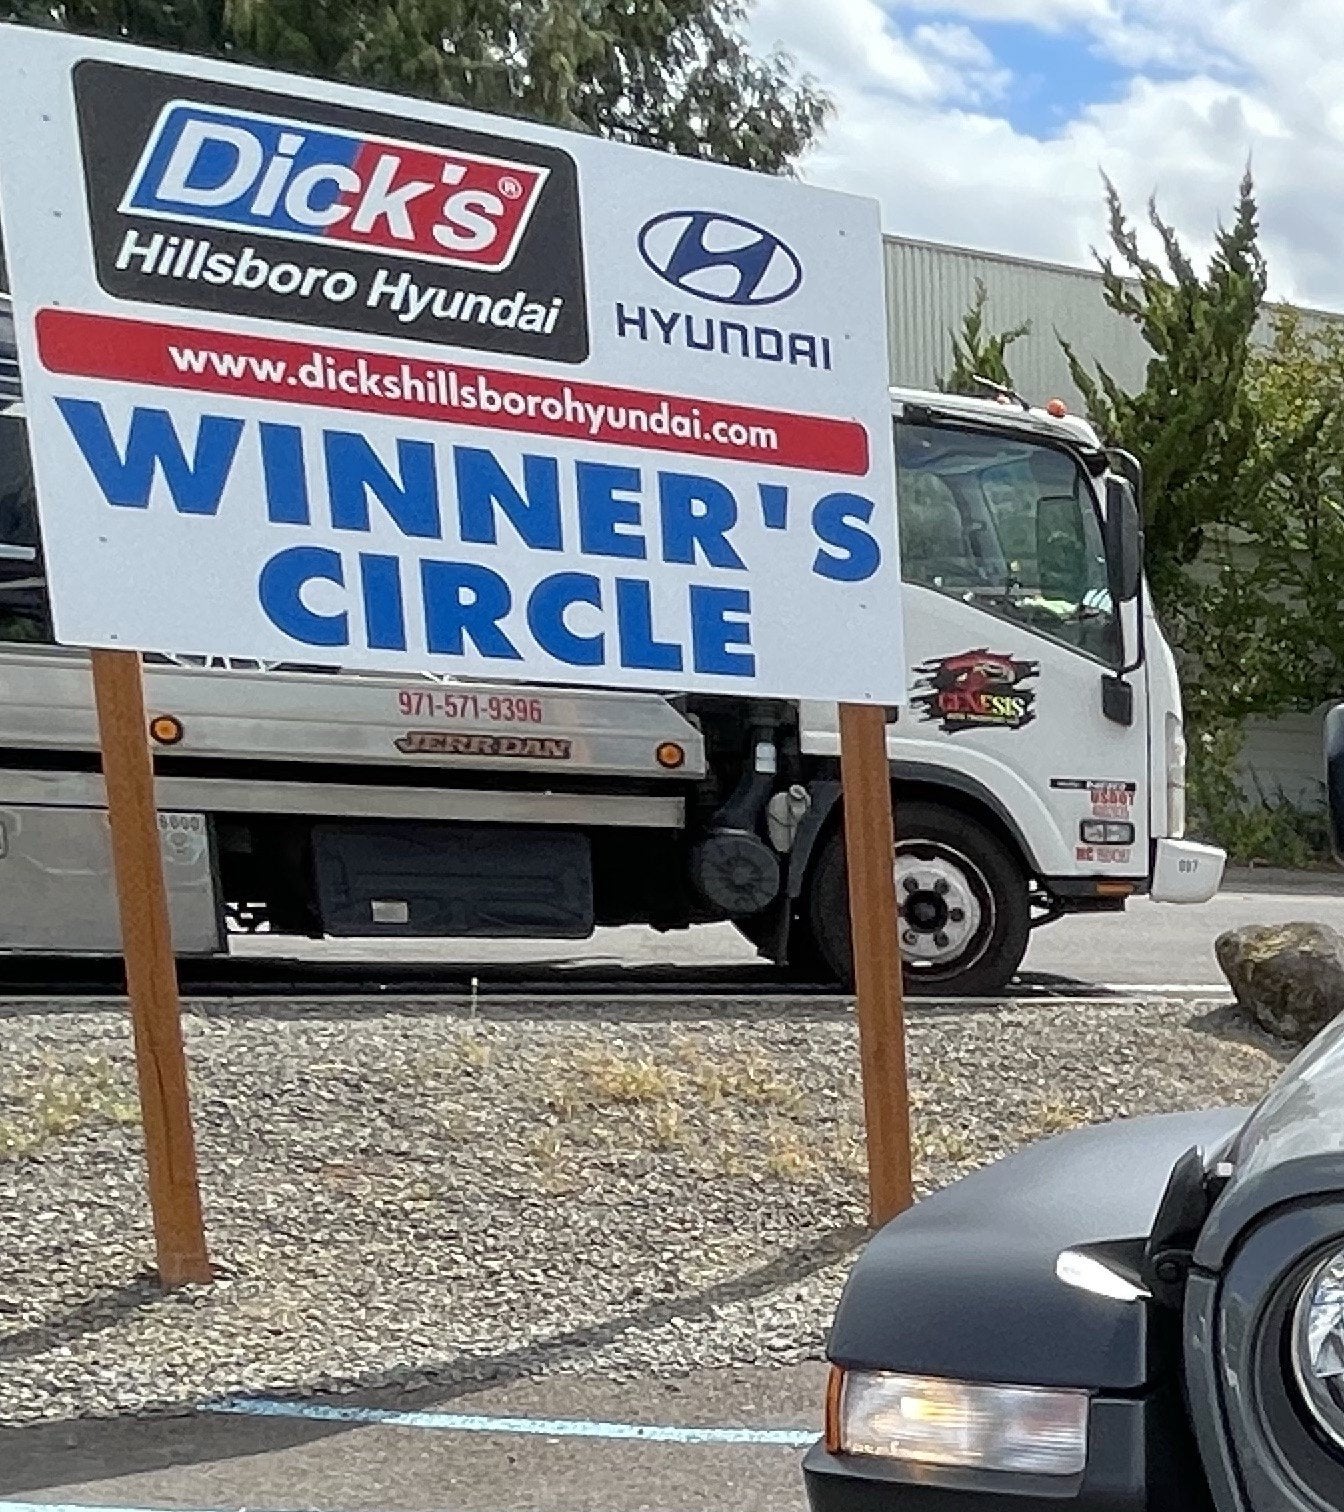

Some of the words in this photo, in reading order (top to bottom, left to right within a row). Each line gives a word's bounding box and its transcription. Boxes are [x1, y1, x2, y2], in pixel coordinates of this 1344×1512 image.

[155, 117, 505, 252] Dick's
[115, 230, 357, 302] Hillsboro
[367, 268, 562, 335] Hyundai
[615, 302, 832, 370] HYUNDAI
[168, 344, 778, 450] www.dickshillsborohyundai.com
[54, 396, 882, 582] WINNER'S
[257, 545, 757, 679] CIRCLE
[399, 691, 542, 724] 971-571-9396
